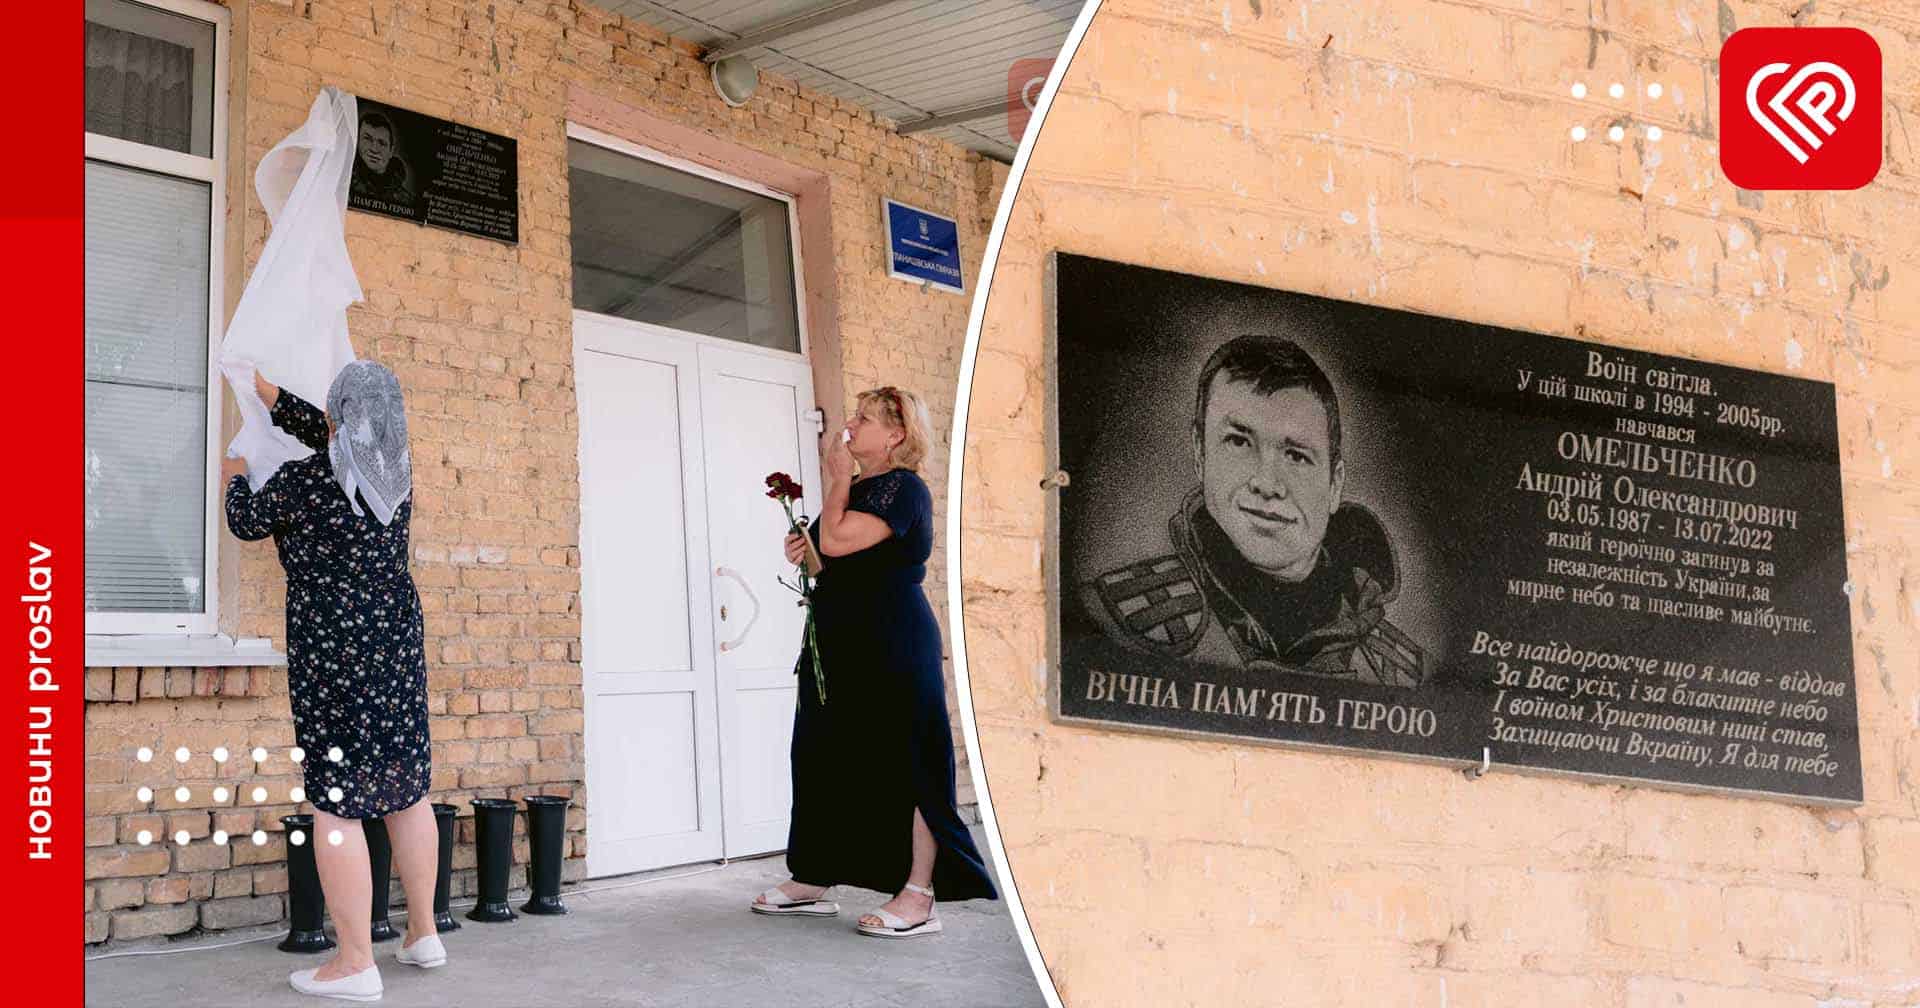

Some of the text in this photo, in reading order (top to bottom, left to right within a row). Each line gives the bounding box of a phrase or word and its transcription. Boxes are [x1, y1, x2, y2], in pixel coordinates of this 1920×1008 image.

[1586, 351, 1718, 397] Воїн світла.
[1517, 369, 1533, 391] У
[1538, 375, 1567, 399] цій
[1574, 386, 1627, 408] школі
[1635, 395, 1645, 410] в
[1654, 392, 1695, 418] 1994
[1717, 402, 1786, 438] 2005рр.
[1616, 417, 1696, 444] навчався
[1557, 431, 1757, 488] ОМЕЛЬЧЕНКО
[1515, 461, 1799, 530] Андрій Олександрович
[1547, 499, 1652, 534] 03.05.1987
[1673, 517, 1774, 551] 13.07.2022
[1546, 531, 1775, 578] який героїчно загинув за
[1546, 558, 1668, 588] незалежність
[1506, 579, 1817, 636] мирне небо та щасливе майбутнє.
[1469, 631, 1513, 657] Все
[1516, 640, 1659, 675] найдорожче
[1663, 661, 1696, 682] що
[1701, 665, 1714, 682] я
[1717, 667, 1761, 688] мав
[1780, 670, 1846, 697] віддав
[1492, 662, 1829, 721] За Вас усіх, і за блакитне небо
[1086, 670, 1437, 737] ВІЧНА ПАМ'ЯТЬ ГЕРОЮ
[1508, 696, 1585, 721] воїном
[1590, 701, 1717, 737] Христовим
[1721, 721, 1768, 742] нині
[1771, 727, 1829, 752] став,
[1488, 717, 1620, 753] Захищаючи
[1718, 743, 1742, 765] Я
[1743, 745, 1780, 771] для
[1784, 751, 1840, 777] тебе
